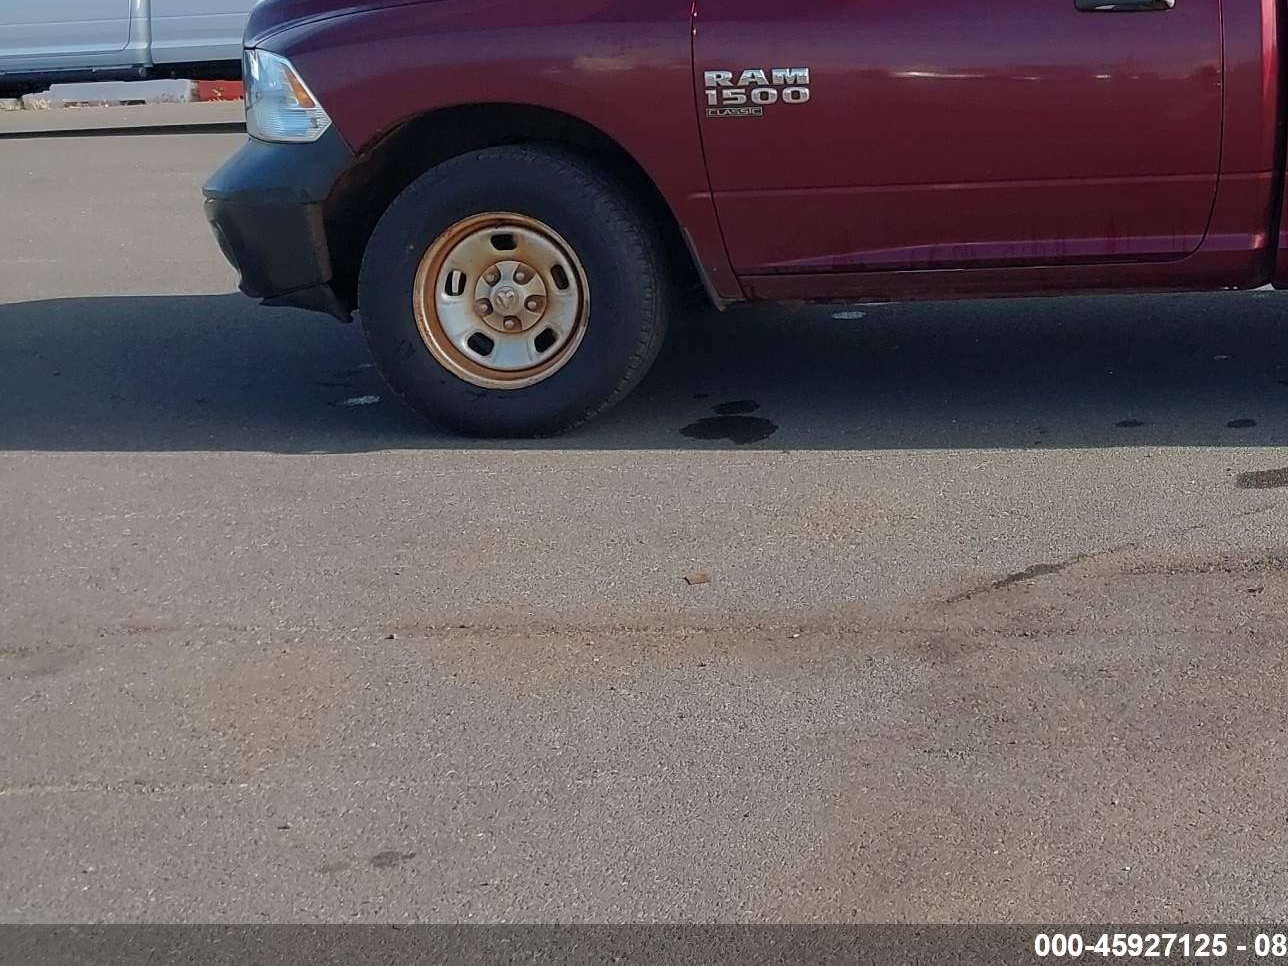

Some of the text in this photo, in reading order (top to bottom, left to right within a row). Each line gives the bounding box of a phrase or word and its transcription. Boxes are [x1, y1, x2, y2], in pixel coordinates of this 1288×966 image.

[704, 68, 810, 87] RAM
[705, 87, 810, 106] 1500
[707, 107, 762, 117] CLASSIC
